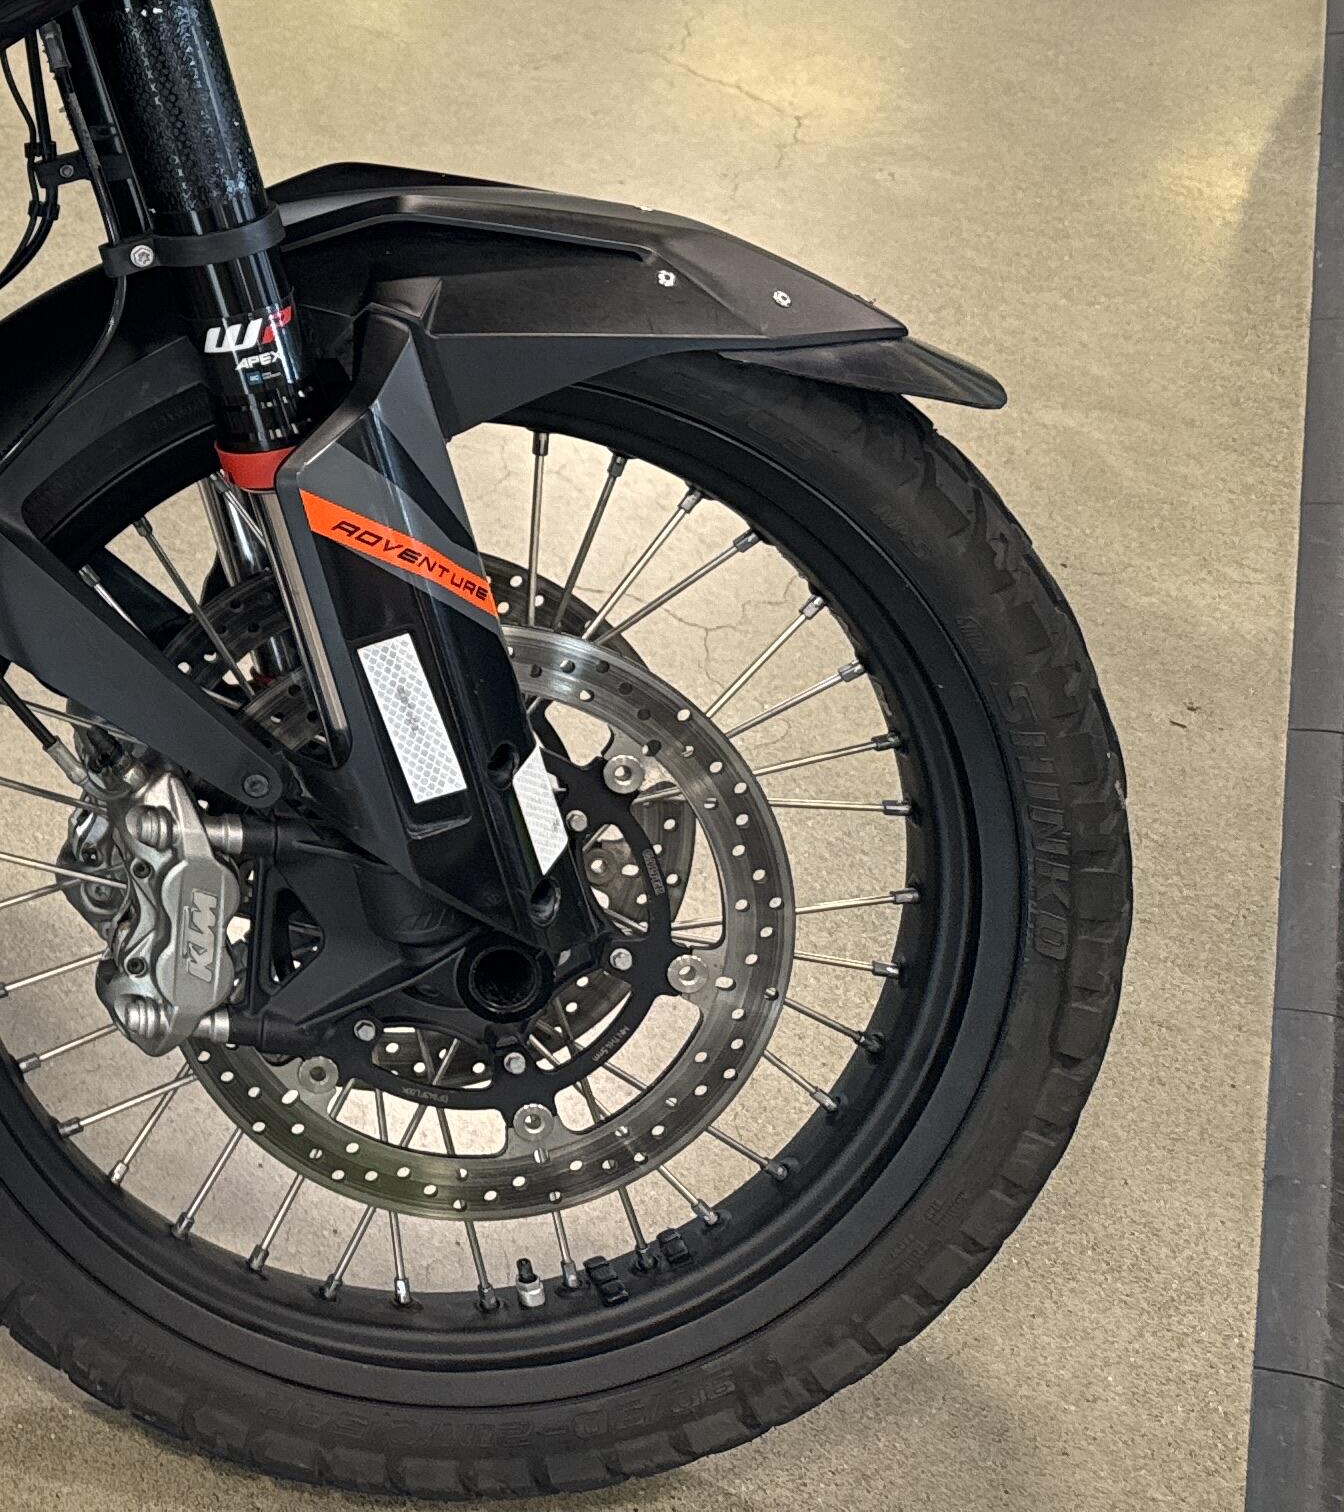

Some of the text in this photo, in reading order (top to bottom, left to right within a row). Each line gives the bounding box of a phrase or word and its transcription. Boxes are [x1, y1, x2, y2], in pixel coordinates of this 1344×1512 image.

[204, 306, 293, 354] WP
[235, 351, 282, 371] APEX
[331, 520, 490, 602] ADVENTURE
[991, 681, 1071, 961] SHINKO
[183, 887, 218, 985] KTM
